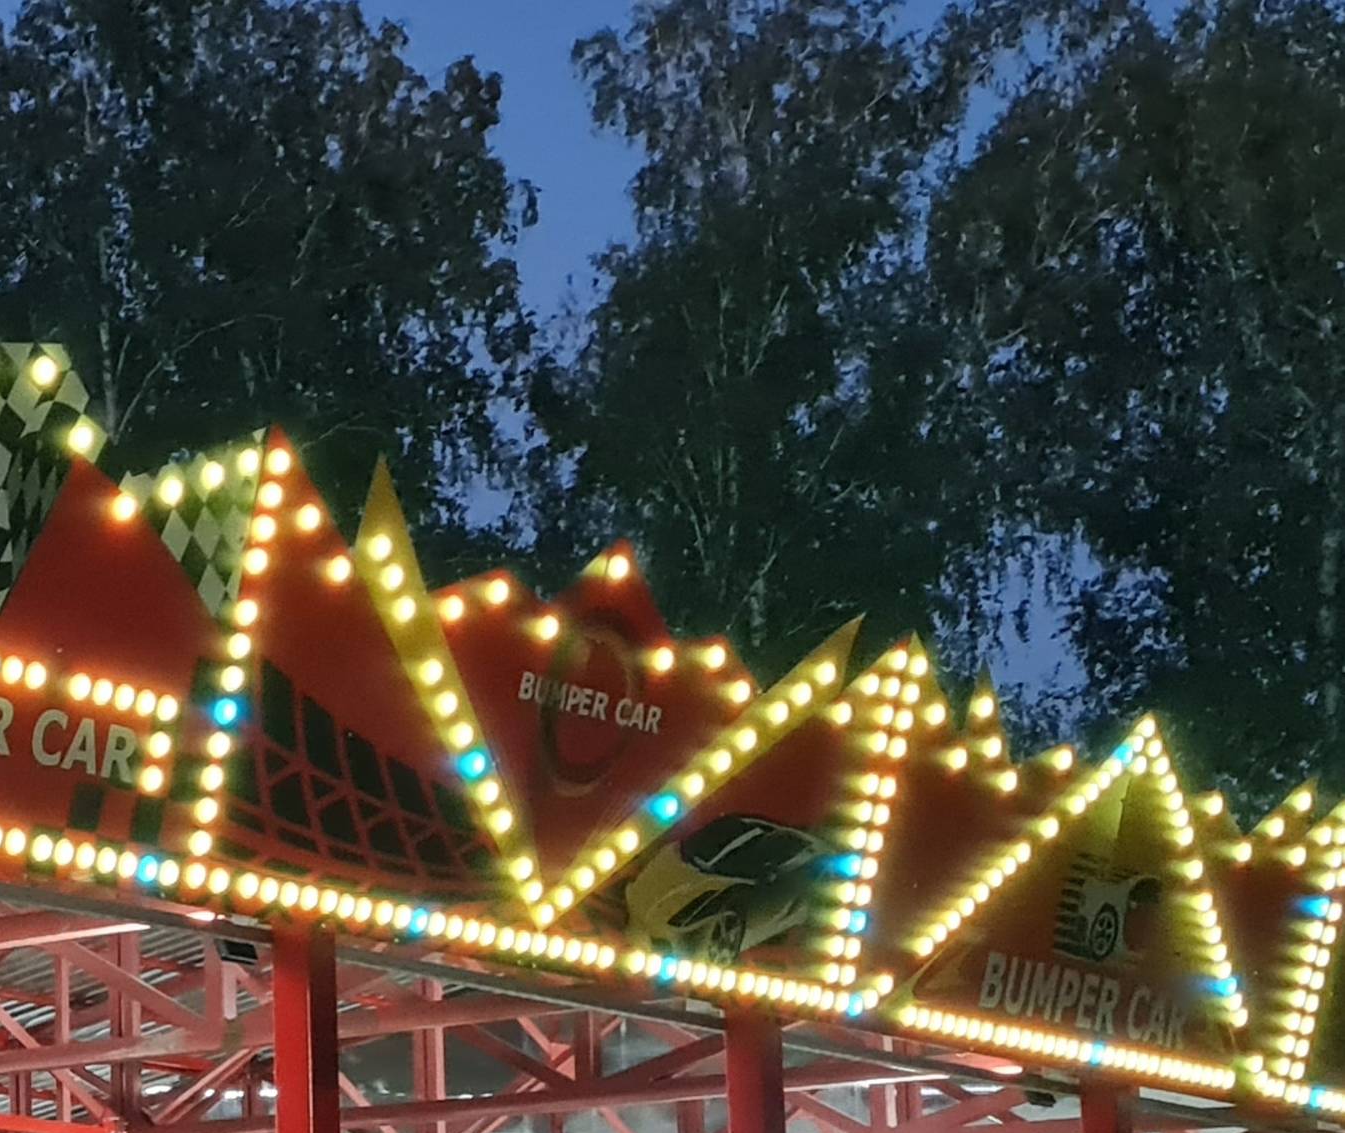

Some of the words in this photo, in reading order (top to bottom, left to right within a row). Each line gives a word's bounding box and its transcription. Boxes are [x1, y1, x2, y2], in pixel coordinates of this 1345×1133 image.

[518, 671, 609, 720] BUMPER
[615, 698, 662, 734] CAR
[31, 709, 137, 784] CAR
[978, 952, 1121, 1035] BUMPER
[1127, 985, 1187, 1050] CAR
